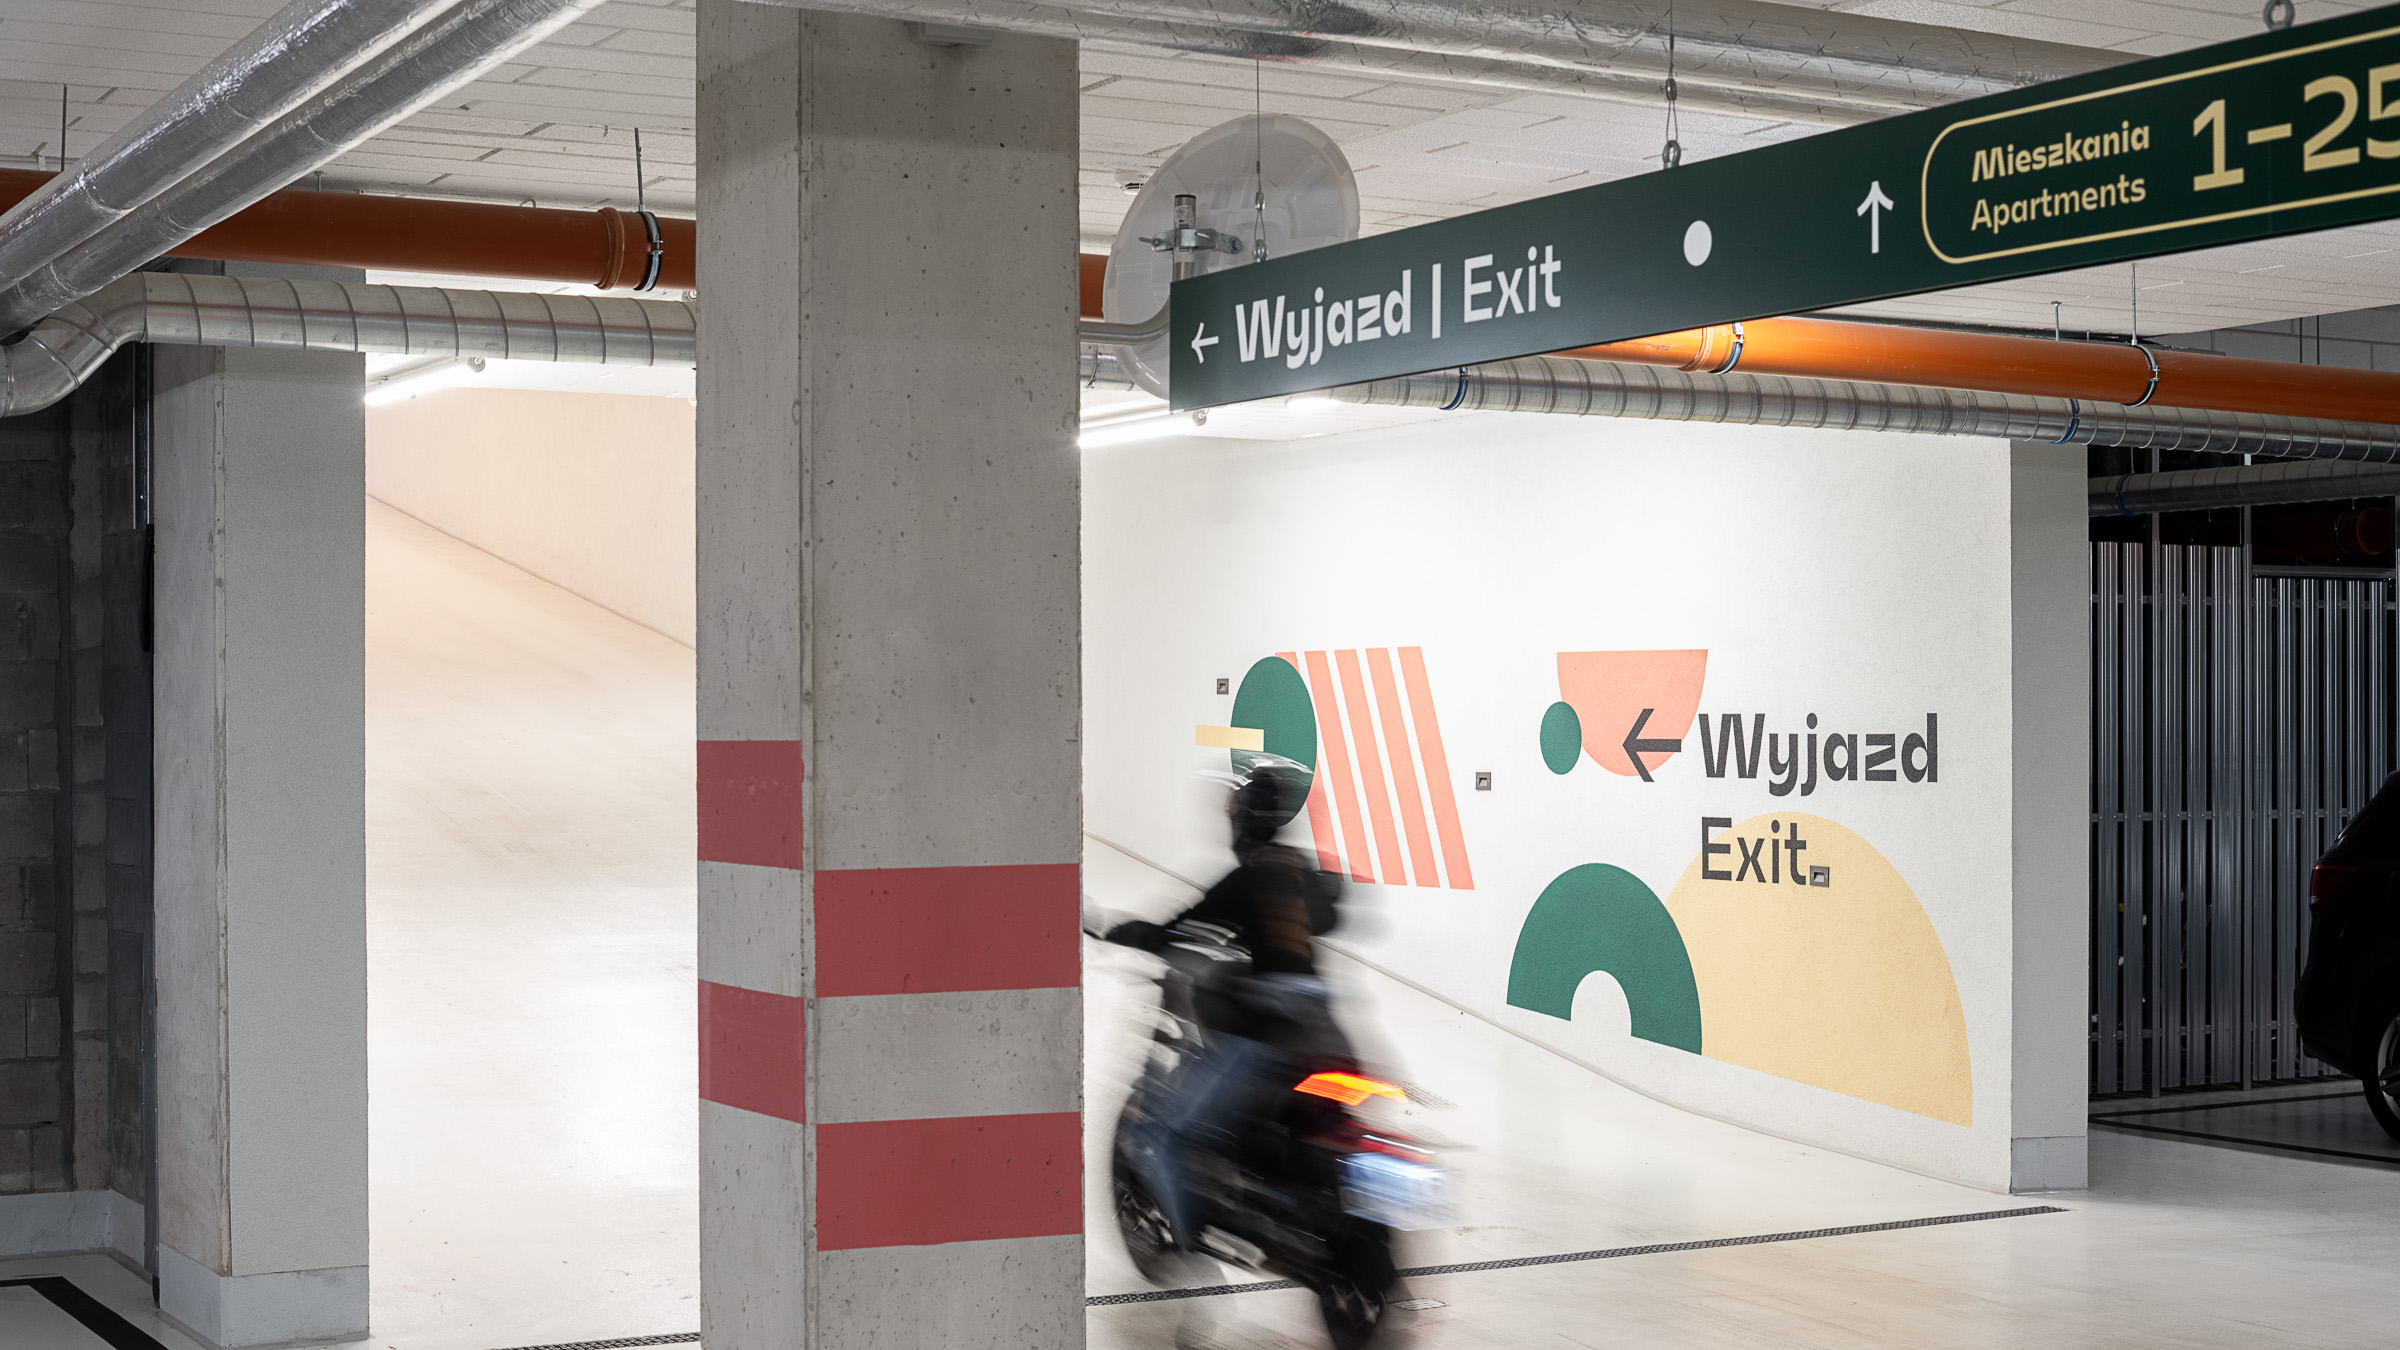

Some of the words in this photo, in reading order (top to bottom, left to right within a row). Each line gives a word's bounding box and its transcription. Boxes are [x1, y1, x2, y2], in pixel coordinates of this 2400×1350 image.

[1971, 120, 2150, 183] Mieszkania
[1971, 175, 2147, 234] Apartments
[1234, 269, 1412, 370] Wyjazd
[1463, 244, 1562, 324] Exit
[1698, 712, 1938, 797] Wyjazd
[1701, 816, 1807, 886] Exit
